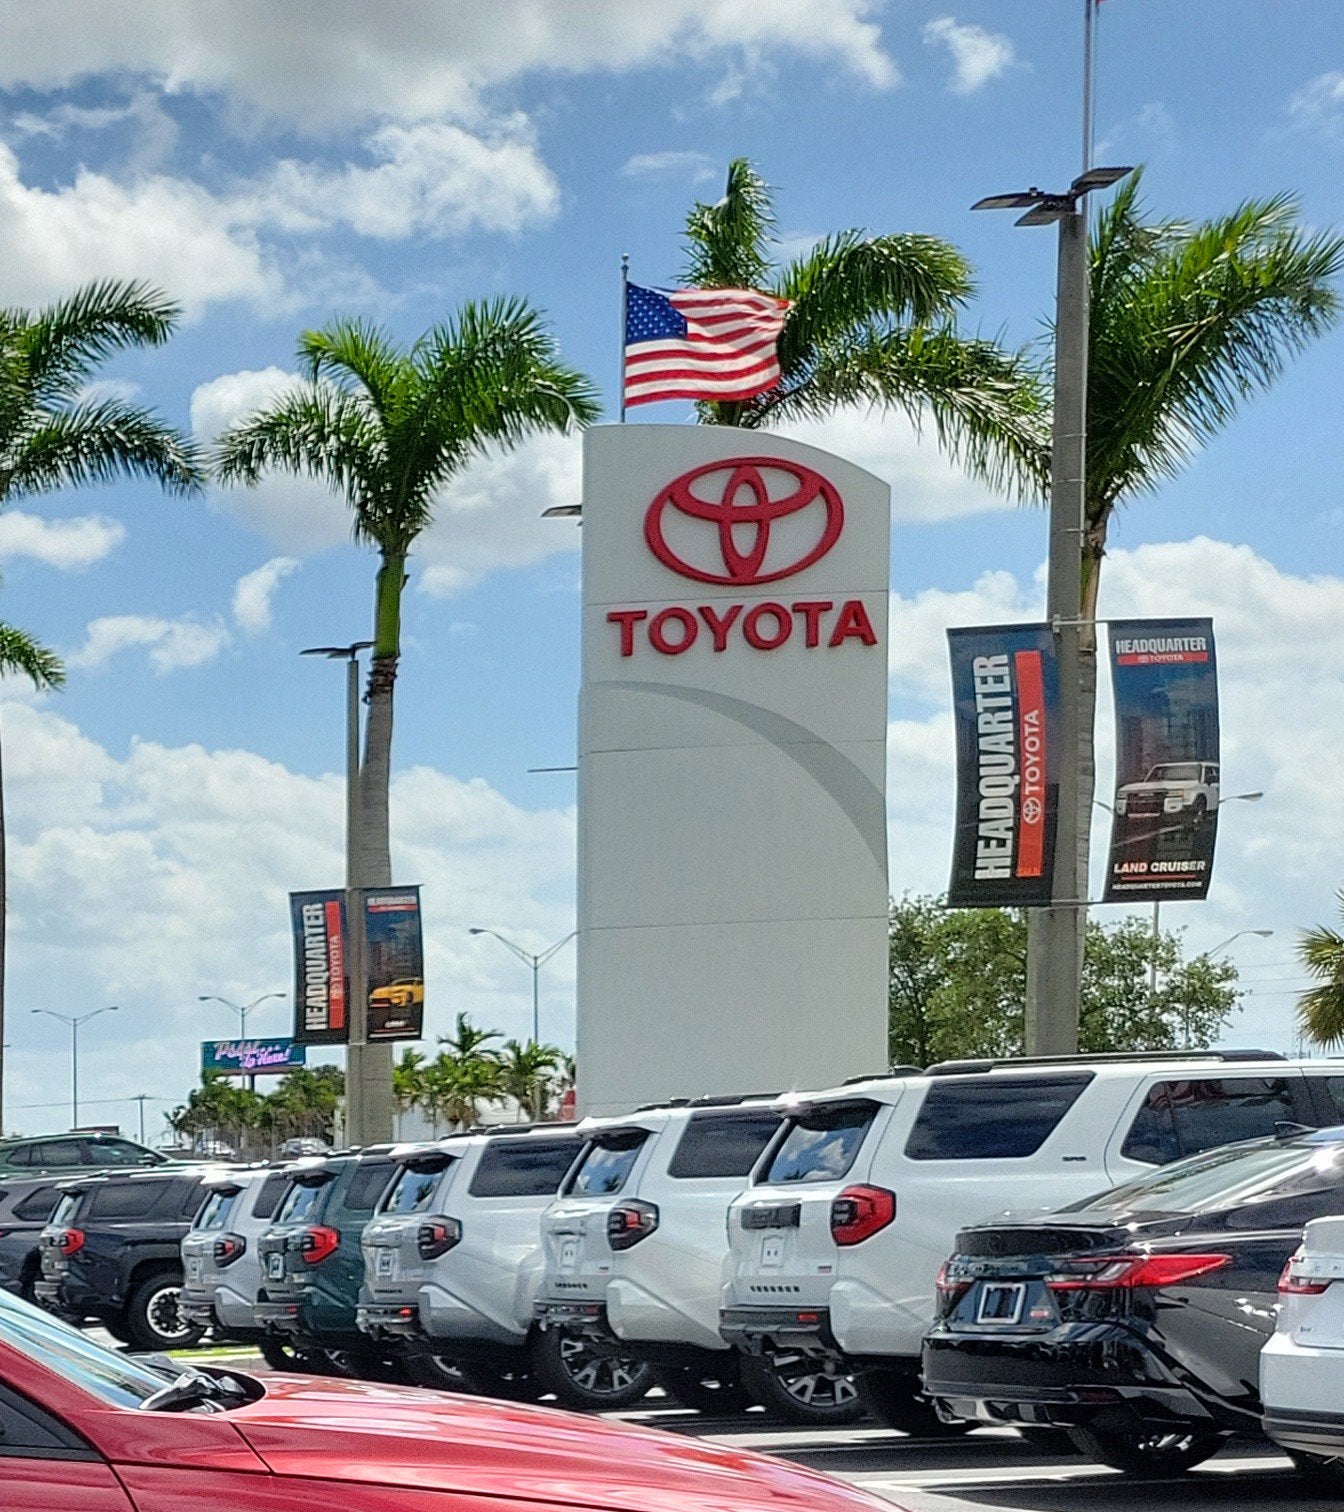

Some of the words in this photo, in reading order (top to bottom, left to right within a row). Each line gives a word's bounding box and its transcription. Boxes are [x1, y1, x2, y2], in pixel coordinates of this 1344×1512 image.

[606, 600, 878, 657] TOYOTA
[1115, 636, 1207, 654] HEADQUARTER
[1150, 653, 1184, 662] TOYOTA
[972, 653, 1020, 879] HEADQUARTER
[1024, 708, 1041, 795] TOYOTA
[1113, 862, 1148, 873] LAND
[1150, 860, 1206, 872] CRUISER
[302, 903, 329, 1031] HEADQUARTER
